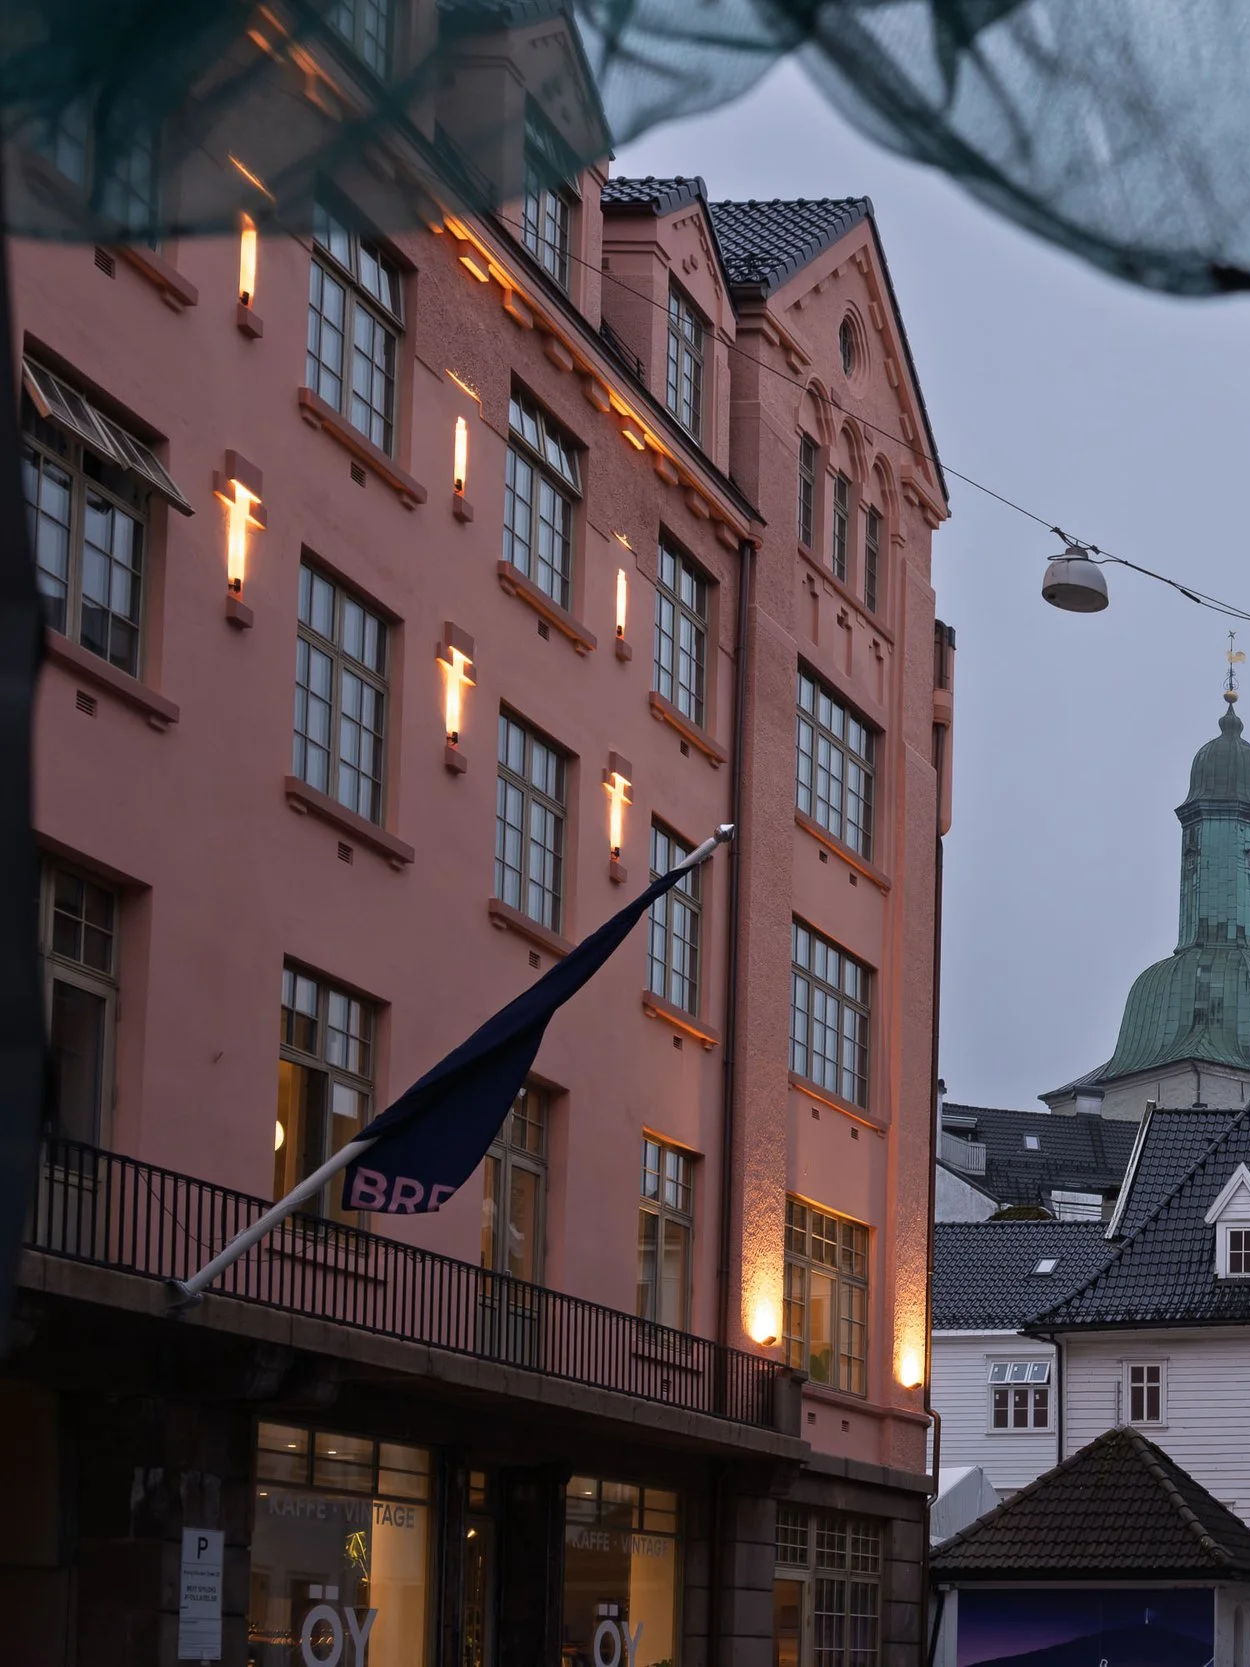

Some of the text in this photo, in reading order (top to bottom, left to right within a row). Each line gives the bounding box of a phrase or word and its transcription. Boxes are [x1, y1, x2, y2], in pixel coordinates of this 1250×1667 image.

[268, 1494, 415, 1529] KAFFE VINTAGE
[197, 1537, 208, 1559] P
[572, 1530, 668, 1557] KAFFE VINTAGE
